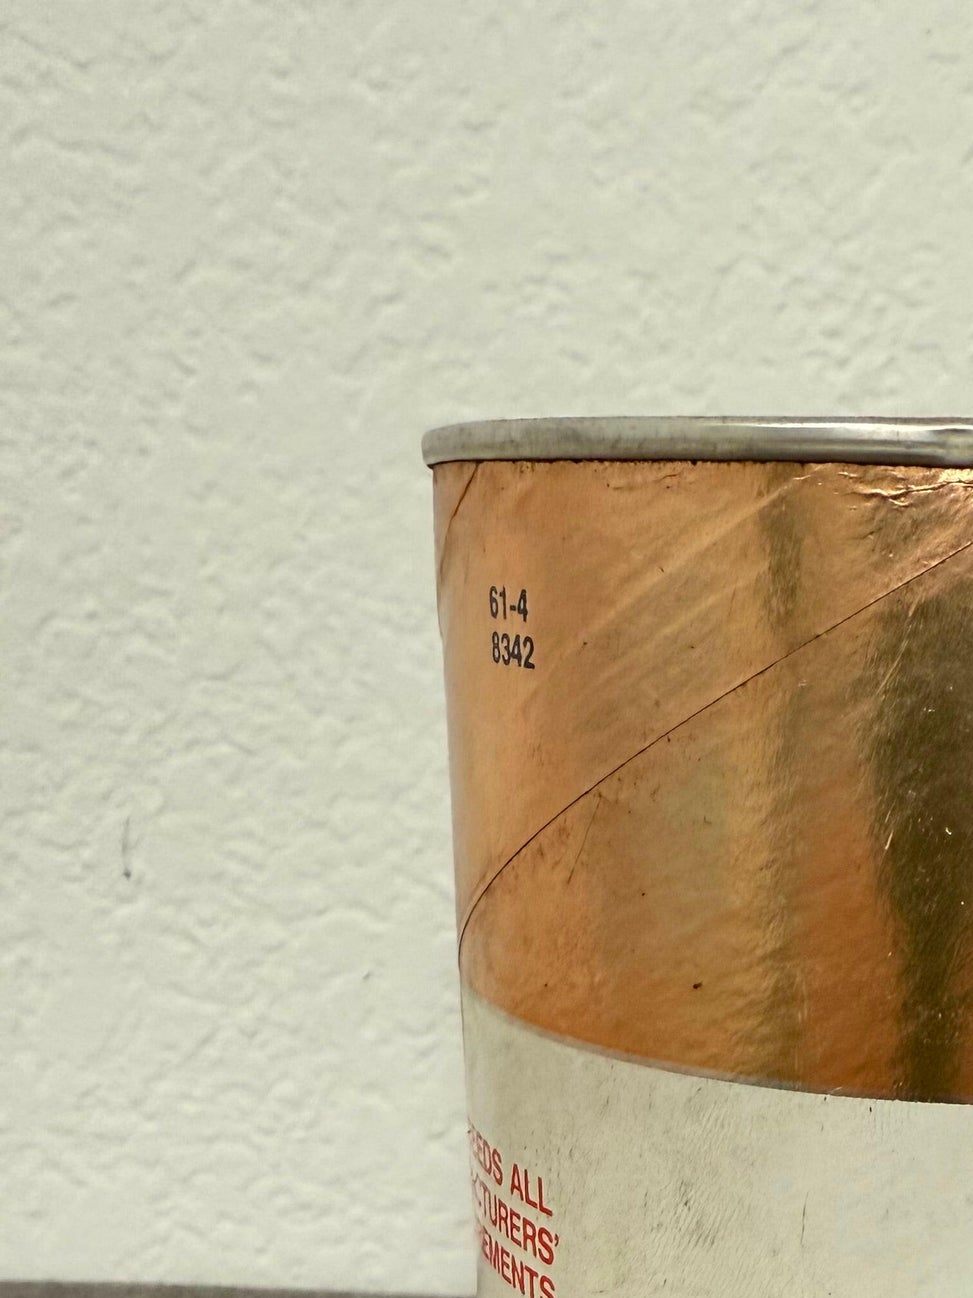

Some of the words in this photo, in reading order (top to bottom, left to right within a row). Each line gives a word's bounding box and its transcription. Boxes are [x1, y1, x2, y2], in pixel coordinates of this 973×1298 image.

[489, 585, 528, 622] 61-4
[492, 631, 535, 670] 8342
[510, 1163, 553, 1217] ALL
